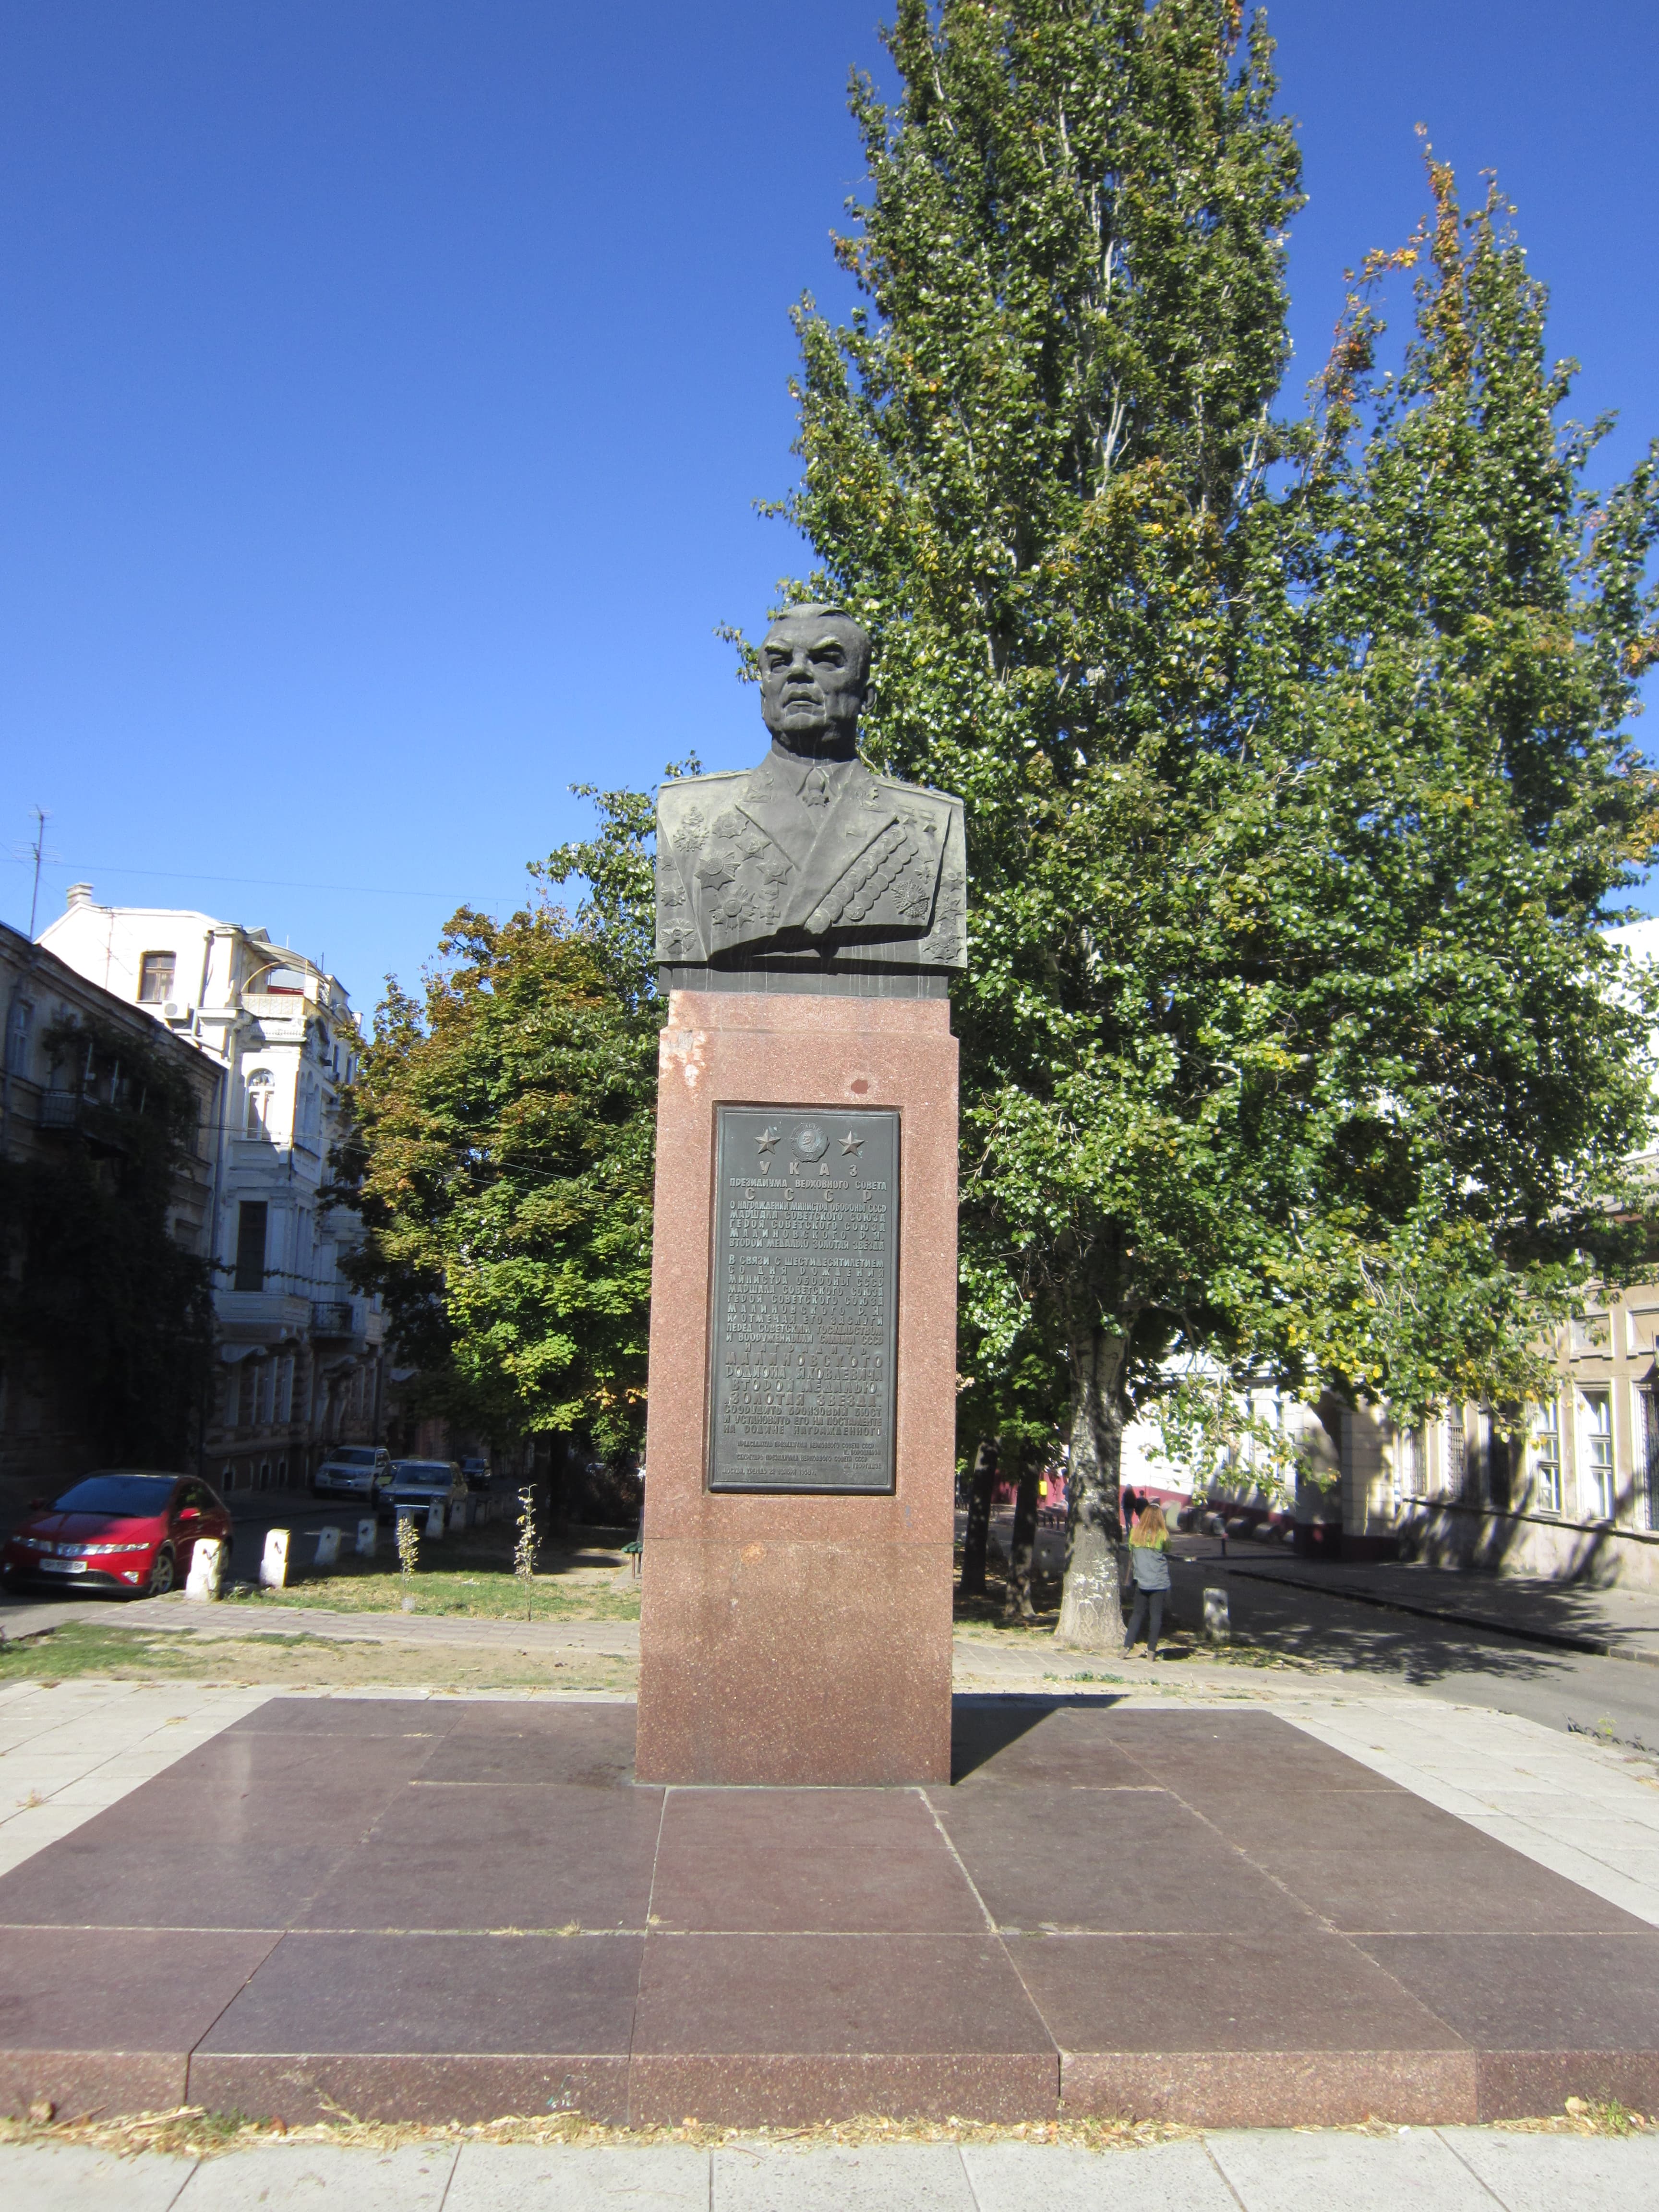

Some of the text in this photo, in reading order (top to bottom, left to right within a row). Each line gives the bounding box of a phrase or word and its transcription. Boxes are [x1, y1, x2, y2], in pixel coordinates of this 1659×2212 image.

[760, 1161, 857, 1177] УКАЗ
[730, 1178, 887, 1190] ПРЕЗИДИУМА ВЕРХОВНОГО СОВЕТА
[730, 1201, 887, 1213] О НАГРАЖДЕНИИ МИНИСТРА ОБОРОНЫ СССР
[730, 1210, 886, 1223] МАРШАЛА СОВЕТСКОГО СОЮЗА
[730, 1219, 886, 1232] ГЕРОЯ СОВЕТСКОГО СОЮЗА
[730, 1228, 846, 1240] МАЛИНОВСКОГО
[729, 1237, 885, 1251] ВТОРОЙ МЕДАЛЬЮ ЗОЛОТАЯ ЗВЕЗДА
[728, 1254, 884, 1268] В СВЯЗИ С ШЕСТИДЕСЯТИЛЕТИЕМ
[729, 1265, 884, 1278] СО ДНЯ РОЖДЕНИЯ
[728, 1274, 884, 1287] МИНИСТРА ОБОРОНЫ СССР
[728, 1285, 884, 1297] МАРШАЛА СОВЕТСКОГО СОЮЗА
[728, 1294, 884, 1307] ГЕРОЯ СОВЕТСКОГО СОЮЗА
[728, 1303, 845, 1316] МАЛИНОВСКОГО
[741, 1313, 796, 1324] ОТМЕЧАЯ
[803, 1314, 822, 1324] ЕГО
[830, 1316, 883, 1326] ЗАСЛУГИ
[727, 1323, 884, 1336] ПЕРЕД СОВЕТСКИМ ГОСУДАРСТВОМ
[726, 1333, 733, 1342] И
[738, 1333, 813, 1344] ВООРУЖЕННЫМИ
[862, 1335, 883, 1345] СССР
[725, 1351, 883, 1368] МАЛИНОВСКОГО
[725, 1365, 883, 1381] РОДИОНА ЯКОВЛЕВИЧА
[732, 1378, 877, 1394] ВТОРОЙ МЕДАЛЬЮ
[724, 1405, 882, 1417] СООРУДИТЬ БРОНЗОВЫЙ БЮСТ
[724, 1415, 882, 1426] И УСТАНОВИТЬ ЕГО НА ПОСТАМЕНТЕ
[723, 1423, 882, 1436] НА РОДИНЕ НАГРАЖДЕННОГО
